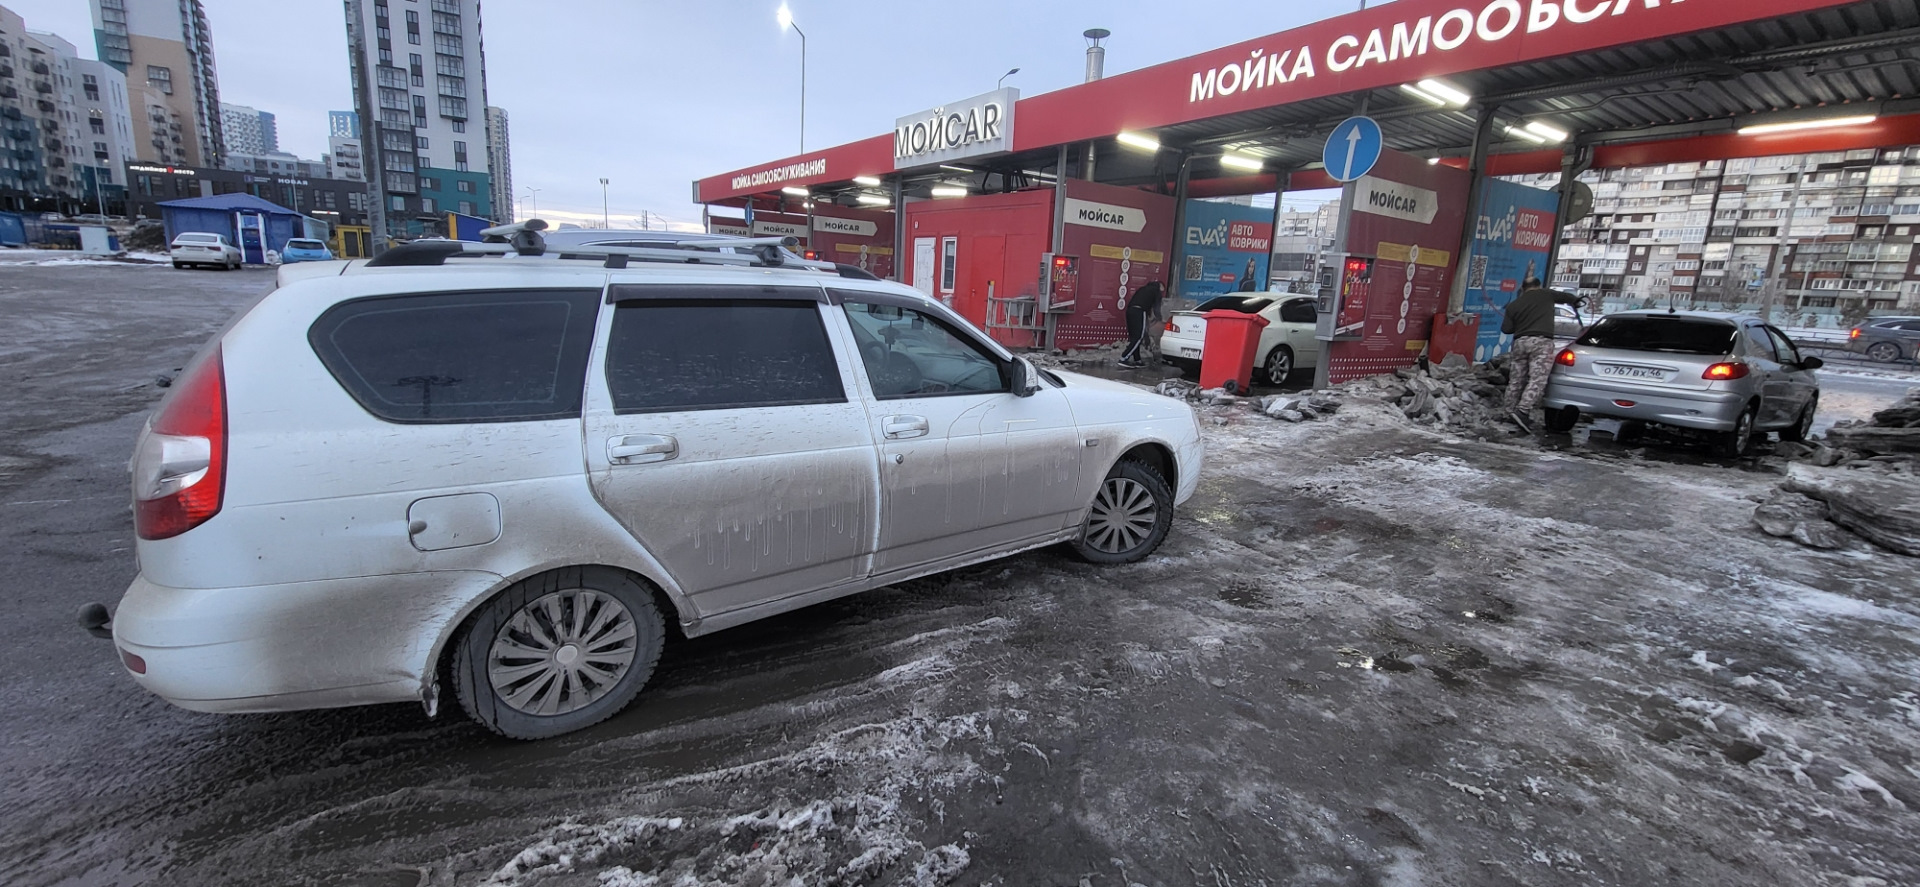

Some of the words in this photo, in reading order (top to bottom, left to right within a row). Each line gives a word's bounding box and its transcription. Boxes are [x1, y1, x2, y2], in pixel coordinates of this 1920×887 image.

[1189, 48, 1315, 103] МОЙКА
[894, 102, 1003, 159] МОЙCAR
[731, 173, 751, 190] МОЙКА
[751, 158, 827, 185] САМООБСЛУЖИВАНИЯ
[1231, 224, 1254, 236] АВТО
[1475, 215, 1507, 243] EVA
[1517, 212, 1539, 229] АВТО
[1186, 226, 1221, 247] EVA
[1230, 236, 1268, 250] КОВРИКИ
[1514, 230, 1551, 248] КОВРИКИ
